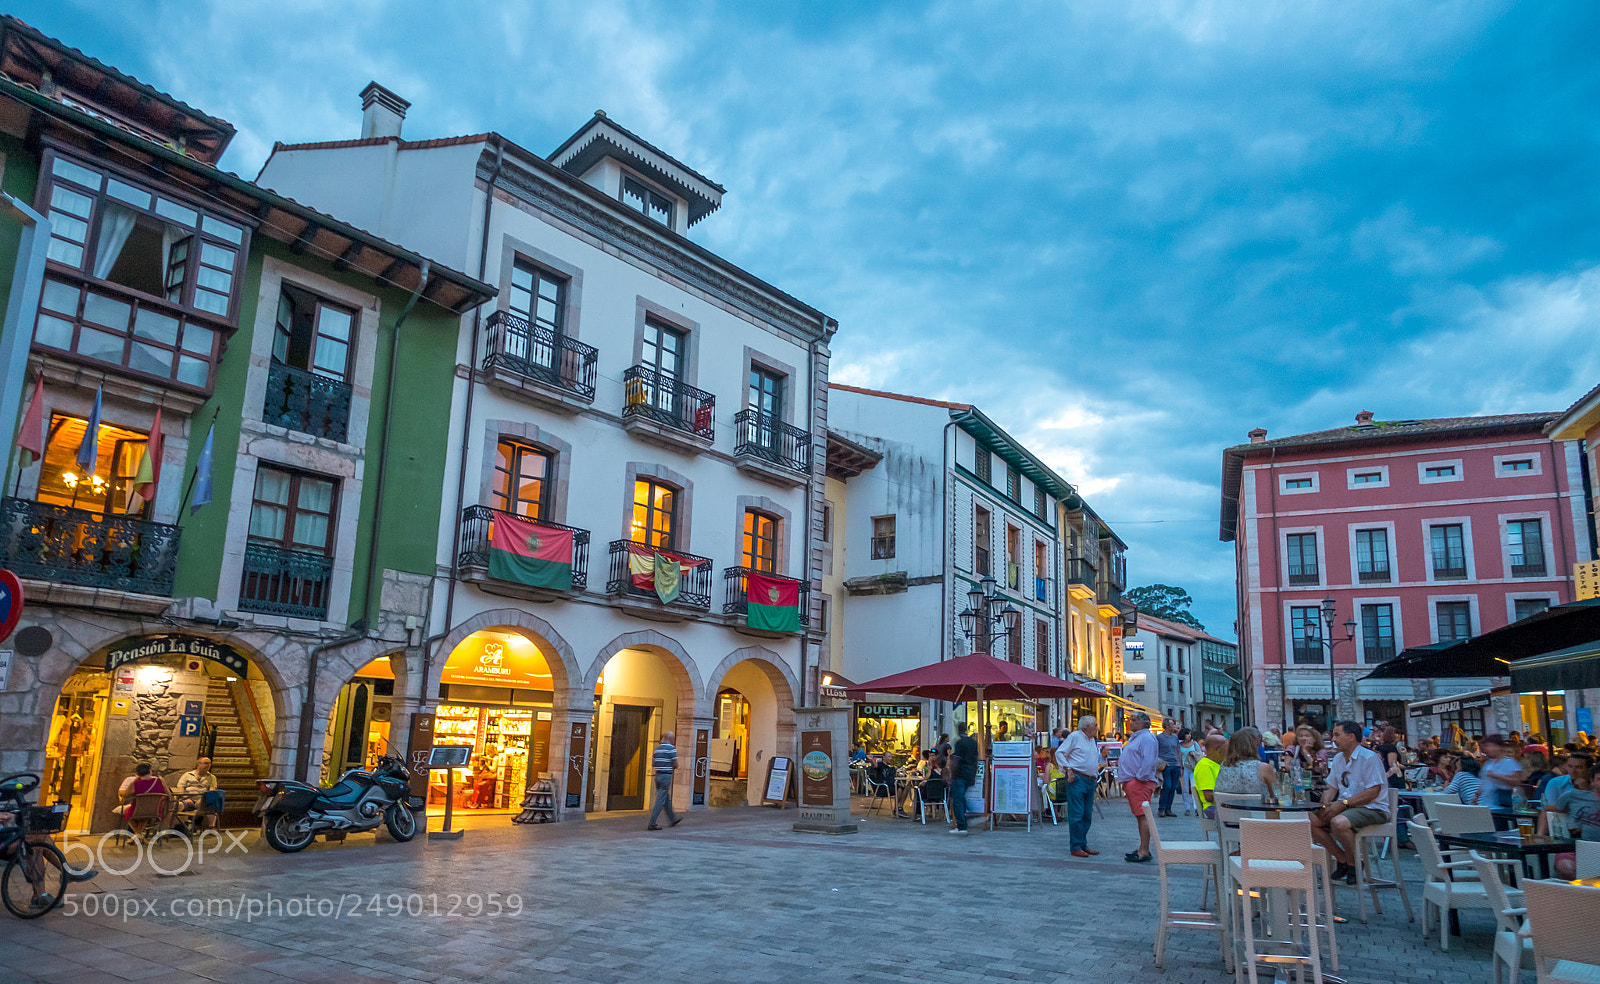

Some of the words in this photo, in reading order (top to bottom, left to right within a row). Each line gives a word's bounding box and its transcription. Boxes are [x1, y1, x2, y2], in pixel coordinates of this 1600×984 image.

[1579, 565, 1587, 589] PASTA
[1592, 581, 1600, 598] ITA
[109, 640, 166, 669] Pensión
[168, 639, 187, 653] La
[189, 641, 221, 660] Guía
[473, 665, 511, 676] ARAMBURU
[1114, 660, 1122, 681] MAYOR
[863, 706, 913, 715] OUTLET
[1432, 701, 1461, 714] BOCAPLAZA
[186, 722, 197, 735] P
